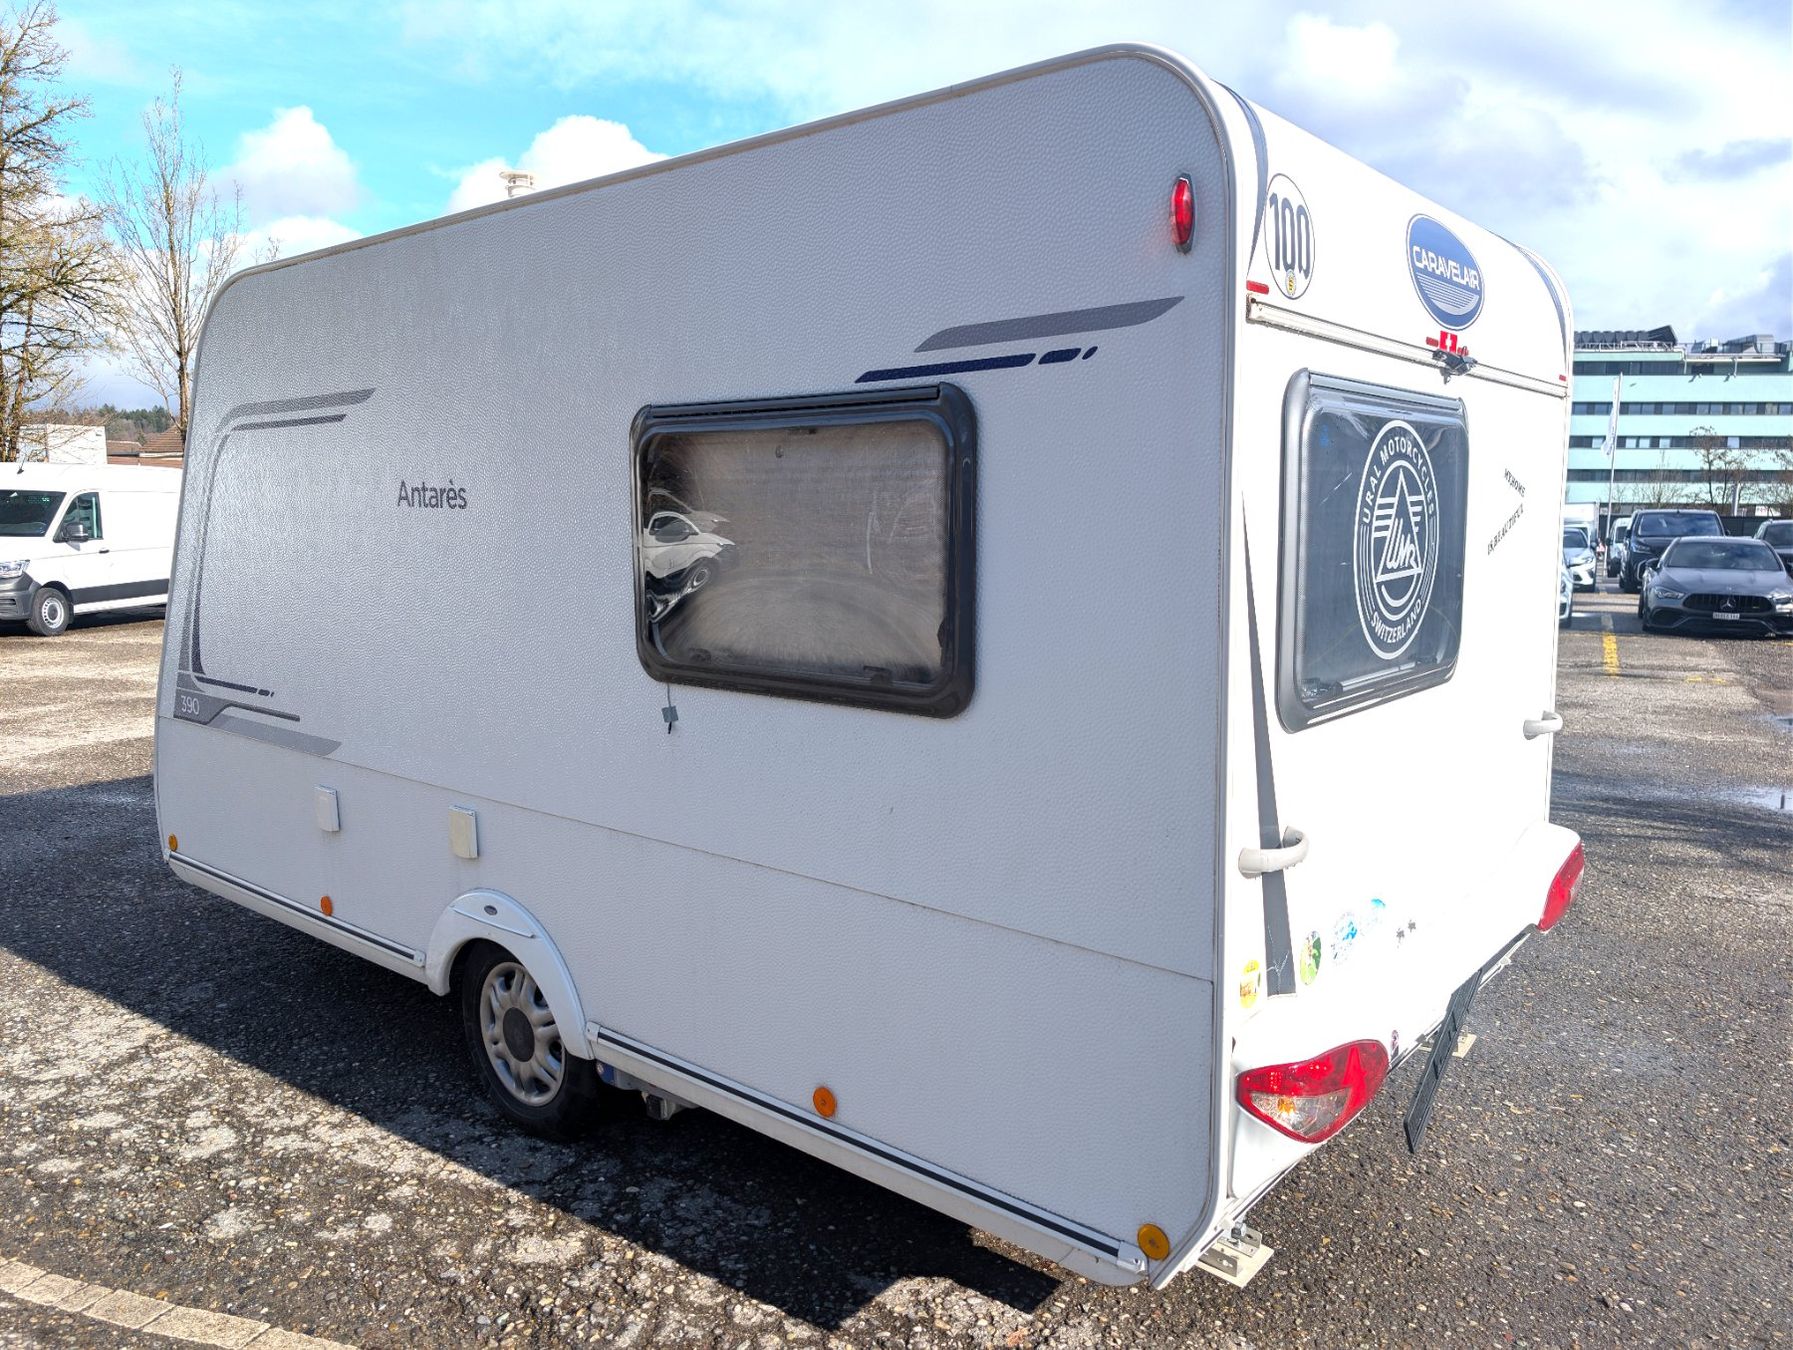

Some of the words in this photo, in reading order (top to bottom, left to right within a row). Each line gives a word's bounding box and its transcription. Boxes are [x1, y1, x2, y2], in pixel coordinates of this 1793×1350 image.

[1269, 192, 1311, 280] 100
[1412, 245, 1480, 290] CARAVELAIR
[397, 479, 468, 510] Antarès
[1362, 464, 1382, 524] URAL
[1380, 436, 1435, 515] MOTORCYCLES
[1371, 598, 1421, 644] SWITZERLAND
[180, 694, 200, 715] 390
